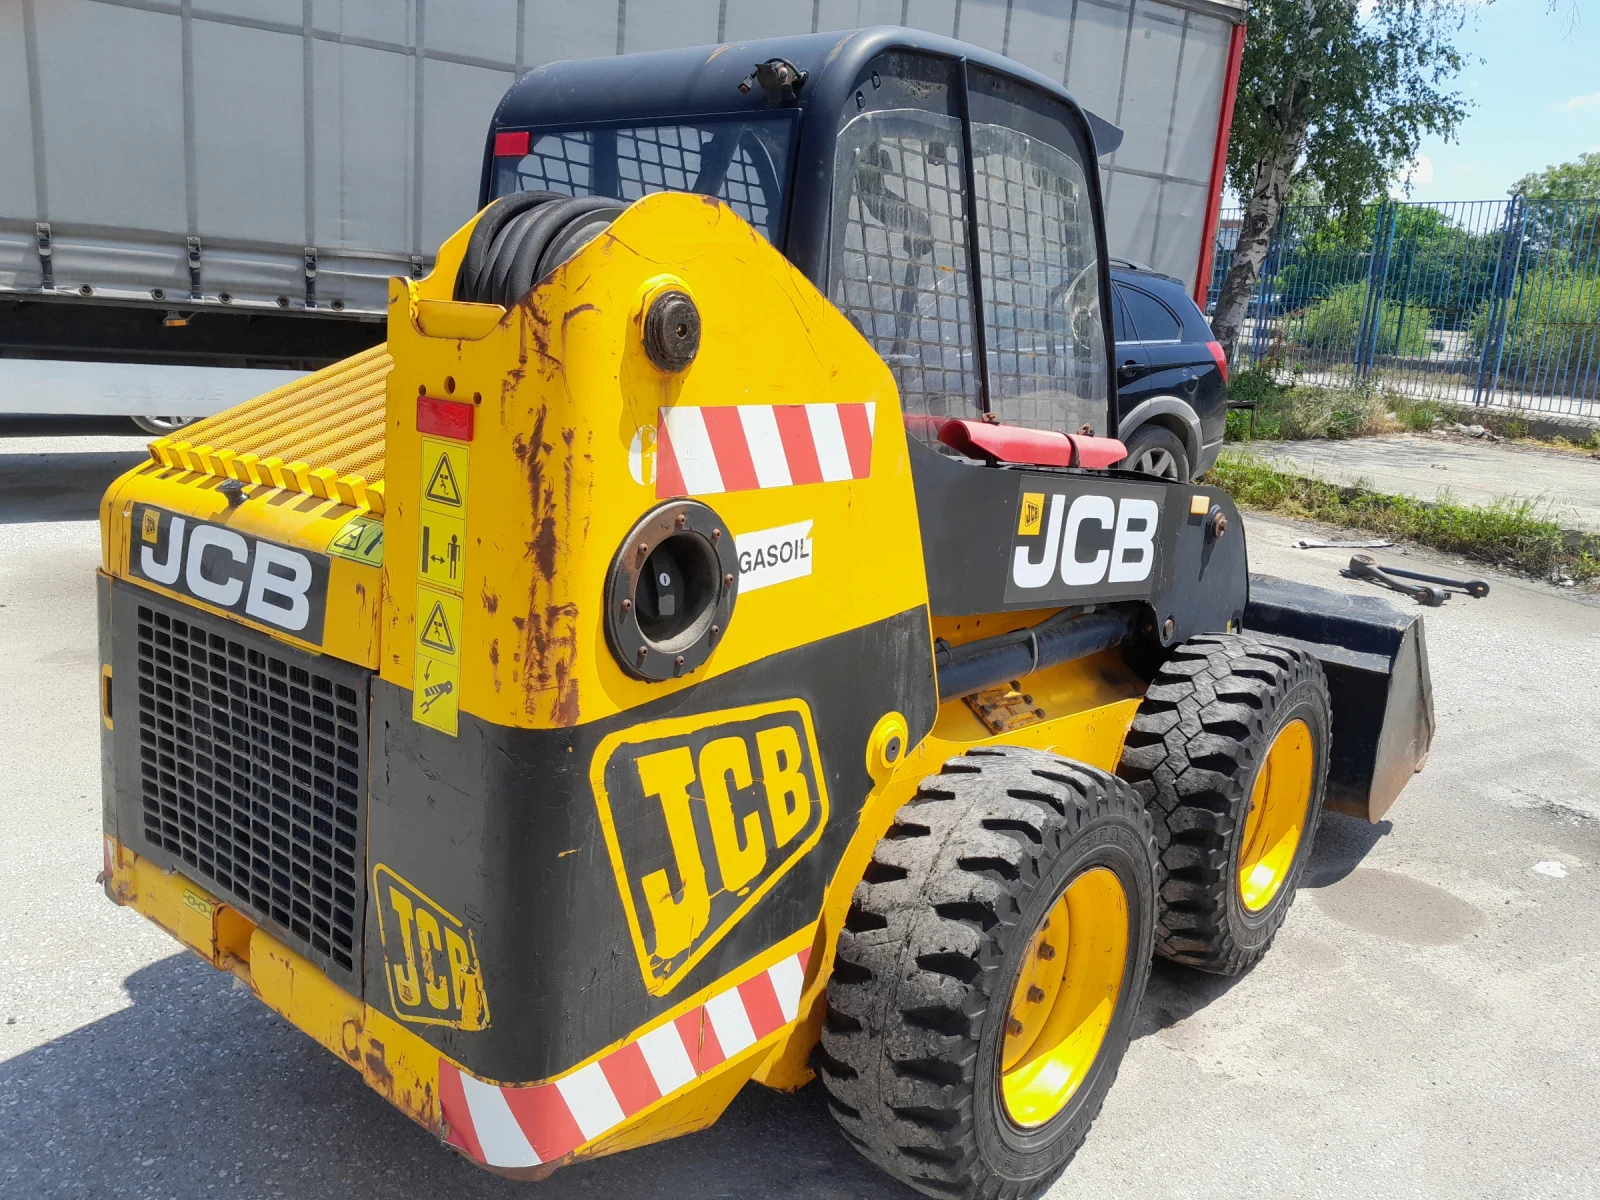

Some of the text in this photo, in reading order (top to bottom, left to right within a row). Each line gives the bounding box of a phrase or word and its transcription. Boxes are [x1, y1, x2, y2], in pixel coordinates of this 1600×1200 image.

[739, 538, 809, 574] GASOIL
[1013, 494, 1159, 589] JCB
[1026, 503, 1038, 524] JCB
[141, 516, 312, 631] JCB
[634, 725, 811, 960] JCB
